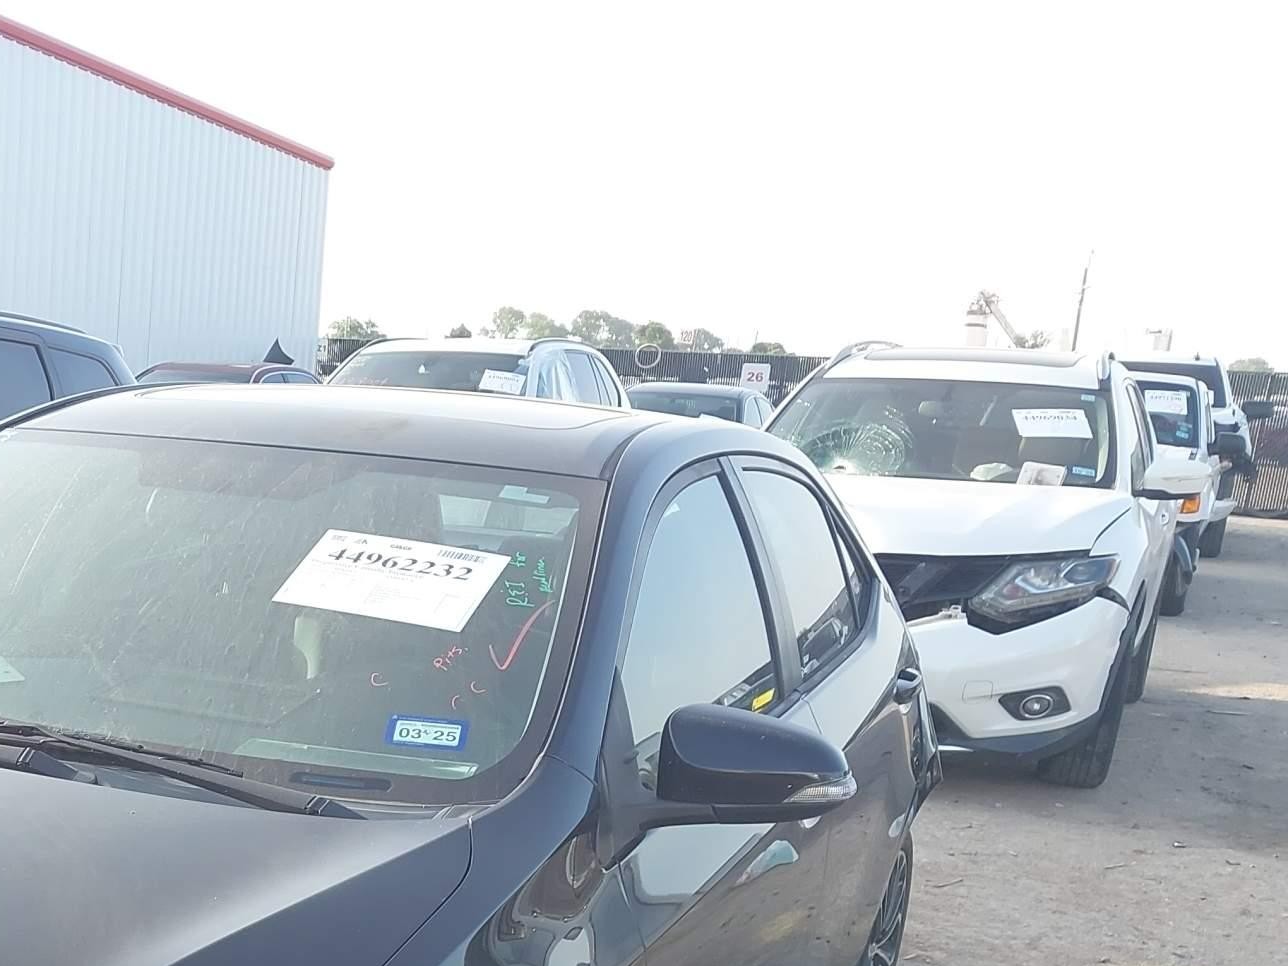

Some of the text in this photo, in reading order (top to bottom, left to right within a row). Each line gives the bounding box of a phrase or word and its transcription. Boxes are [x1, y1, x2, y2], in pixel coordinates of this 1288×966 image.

[746, 371, 764, 383] 26
[327, 548, 474, 581] 44962232
[398, 727, 458, 742] 03 25
